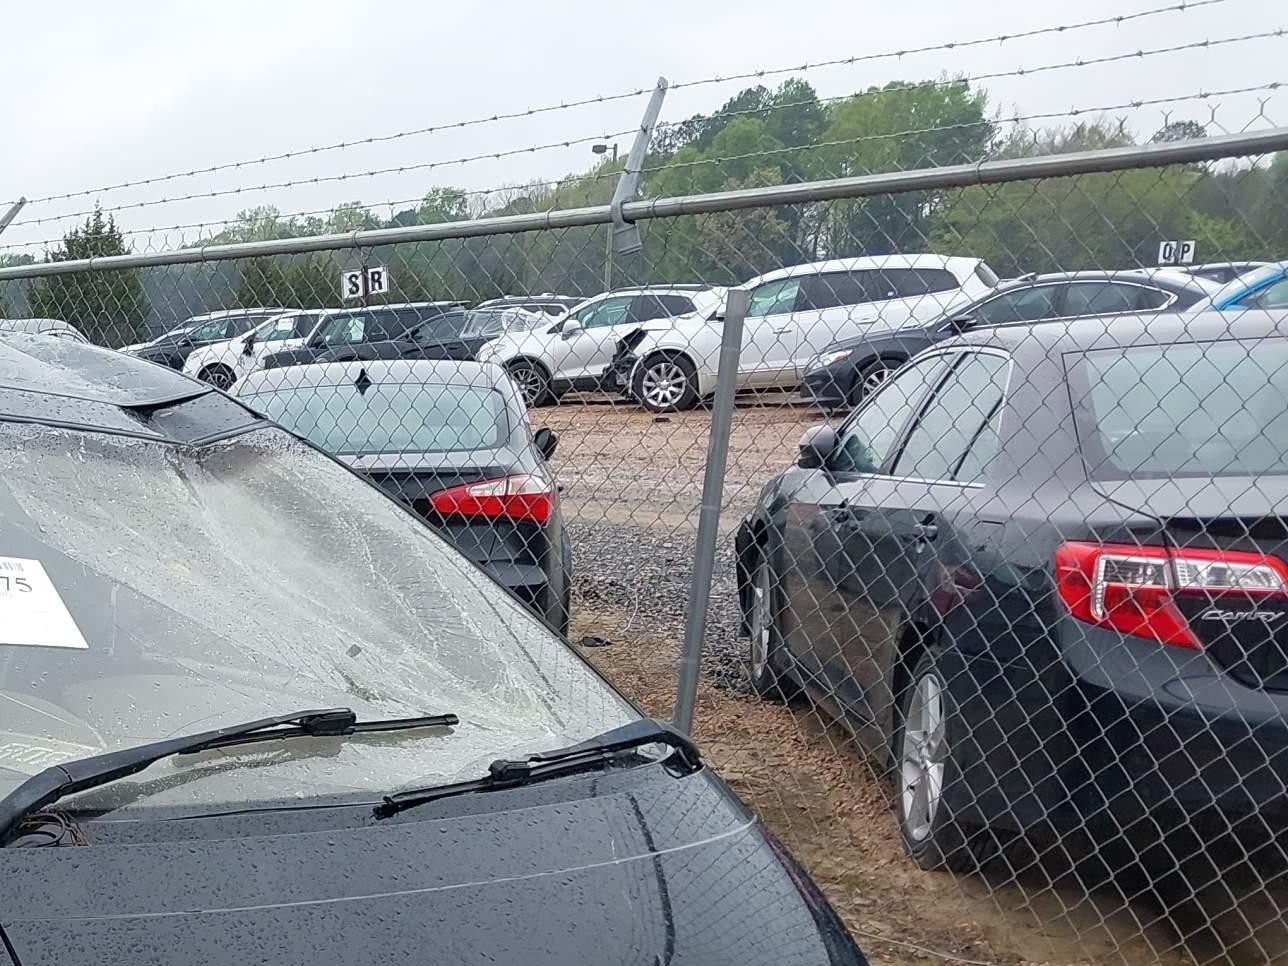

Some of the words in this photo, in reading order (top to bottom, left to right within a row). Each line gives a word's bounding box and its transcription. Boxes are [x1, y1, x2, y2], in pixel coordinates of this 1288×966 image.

[1180, 243, 1191, 260] P
[348, 273, 360, 295] S
[370, 270, 383, 292] R
